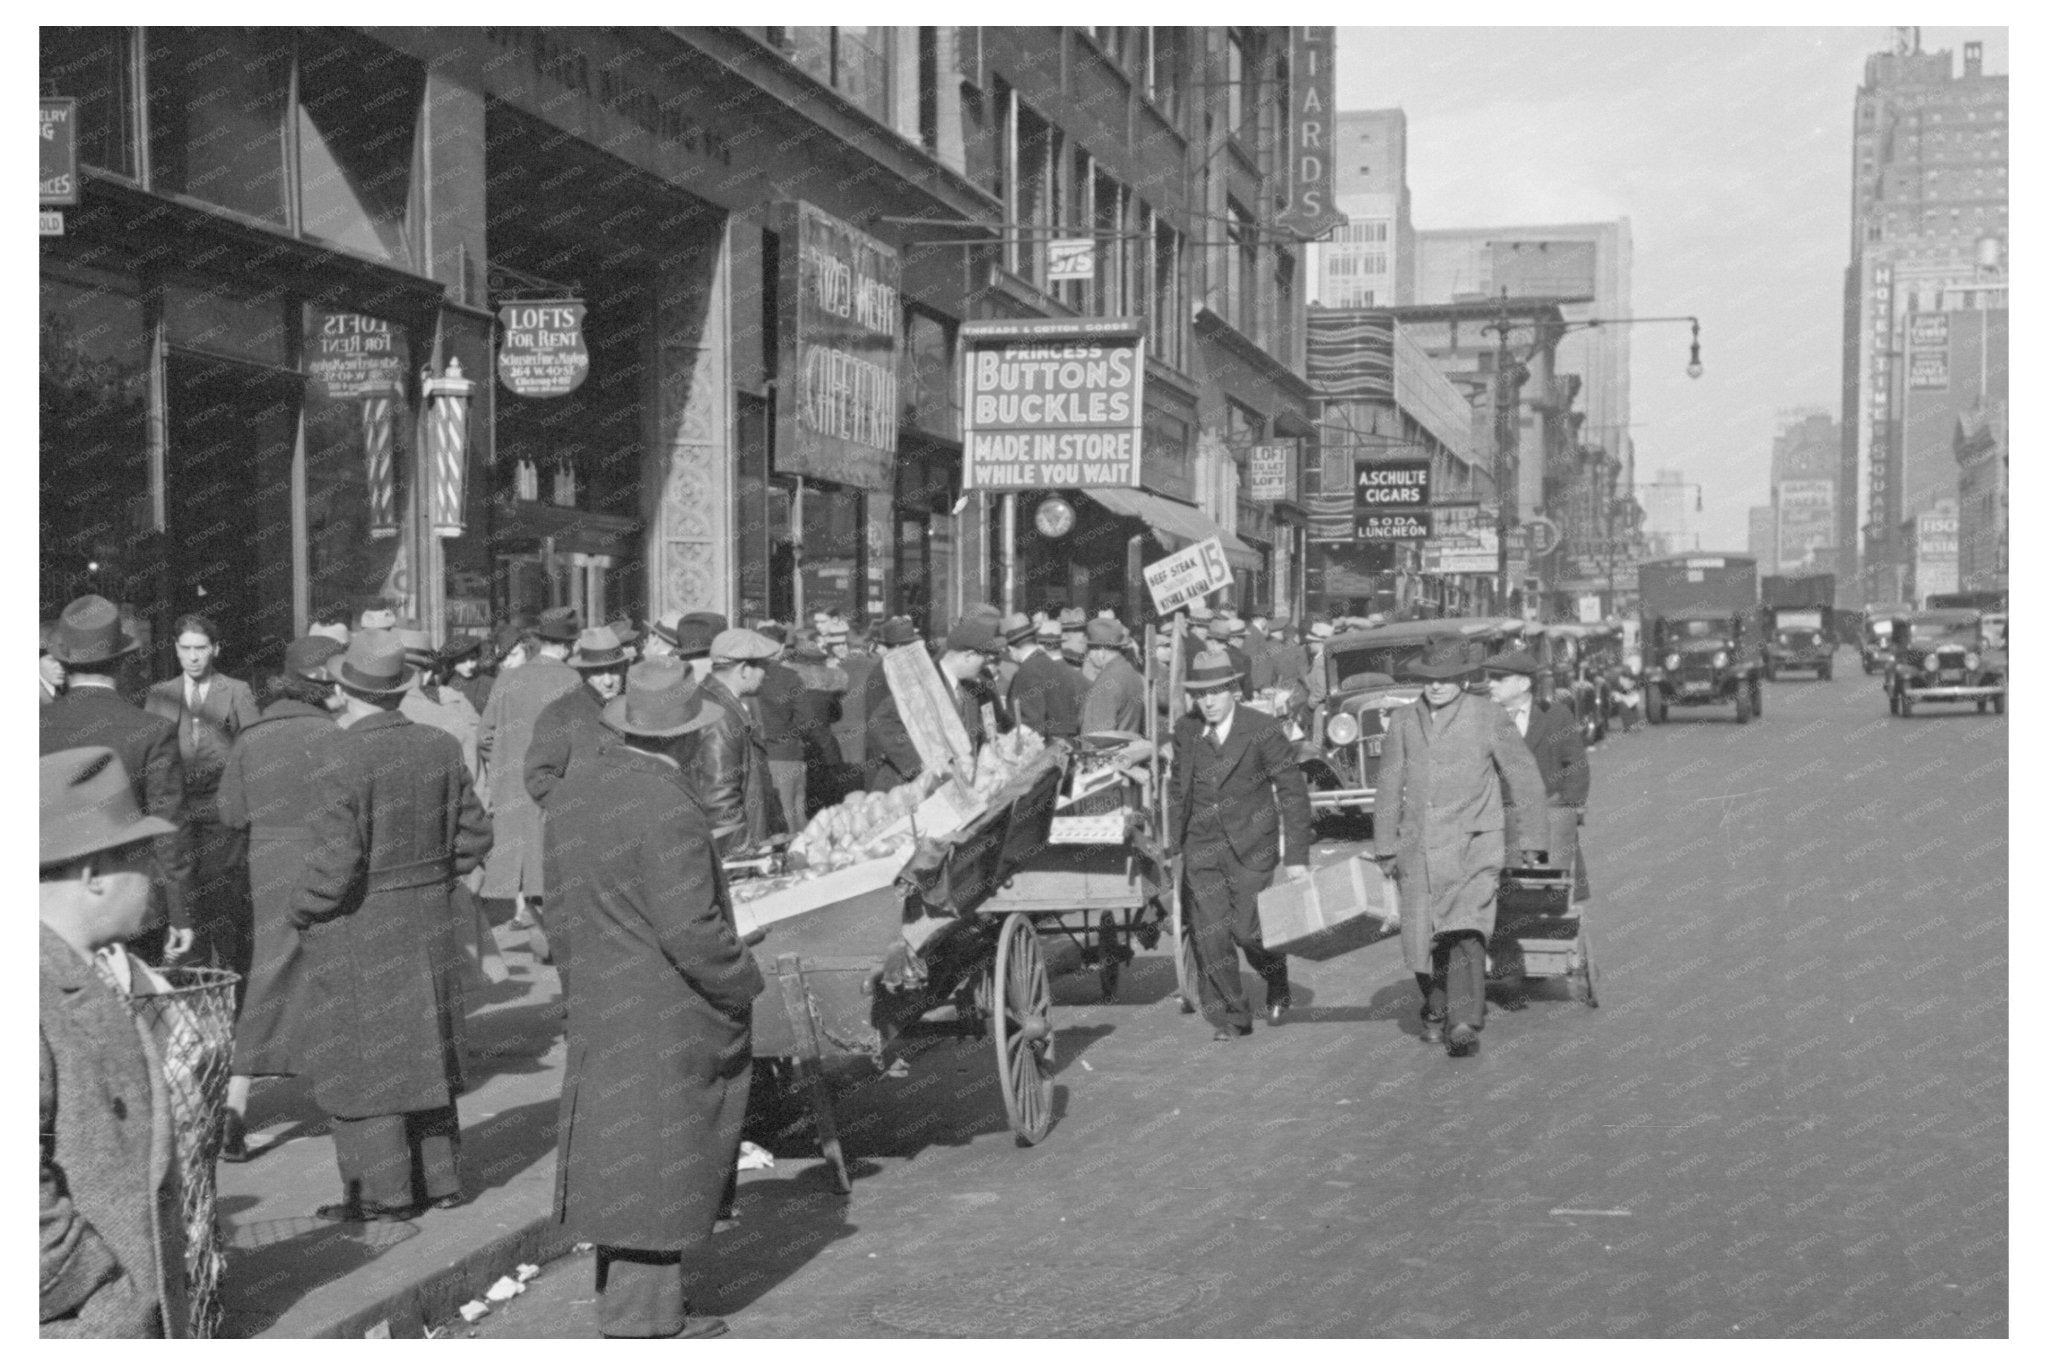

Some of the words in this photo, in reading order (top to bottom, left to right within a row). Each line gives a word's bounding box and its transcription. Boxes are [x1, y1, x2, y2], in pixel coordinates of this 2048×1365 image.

[511, 308, 575, 329] LOFTS
[1085, 323, 1129, 332] GOODS
[507, 330, 534, 348] FOR
[538, 330, 578, 347] RENT
[510, 366, 530, 377] 264
[977, 348, 1133, 391] BUTTONS
[976, 392, 1130, 424] BUCKLES
[975, 434, 1030, 462] MADE
[1034, 434, 1056, 461] IN
[1058, 433, 1131, 461] STORE
[975, 464, 1035, 485] WHILE
[1041, 463, 1079, 484] YOU
[1083, 463, 1130, 484] WAIT
[1365, 488, 1420, 503] CIGARS
[1368, 517, 1418, 526] SODA
[1358, 526, 1428, 538] LUNCHEON
[1198, 542, 1226, 586] 15
